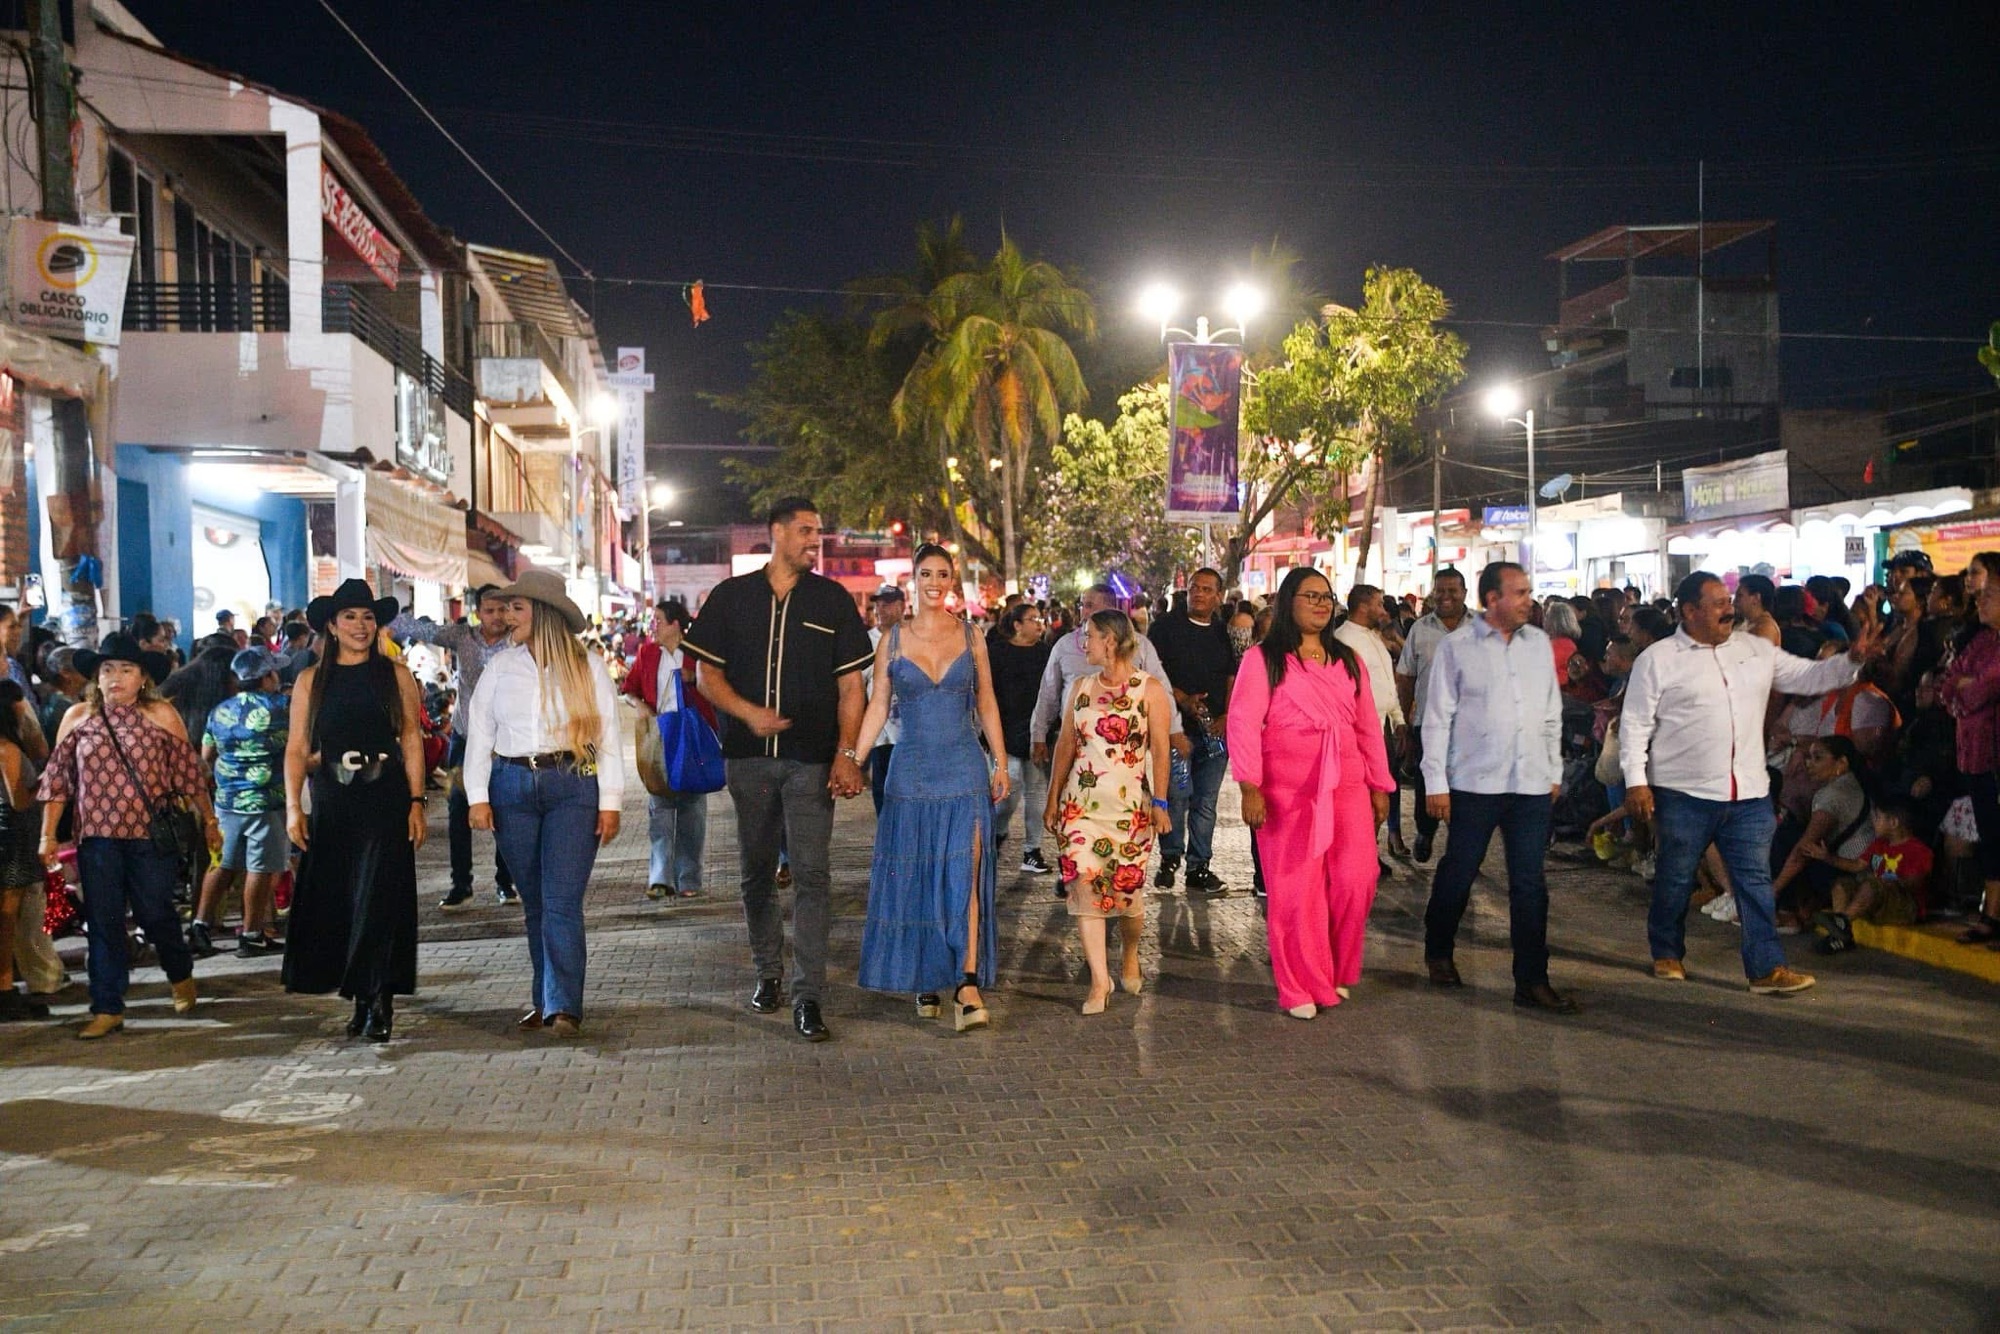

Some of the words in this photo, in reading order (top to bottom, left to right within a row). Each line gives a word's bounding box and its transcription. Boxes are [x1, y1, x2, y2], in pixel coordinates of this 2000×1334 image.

[41, 291, 86, 307] CASCO
[20, 302, 109, 324] OBLIGATORIO
[1845, 539, 1865, 552] TAXI
